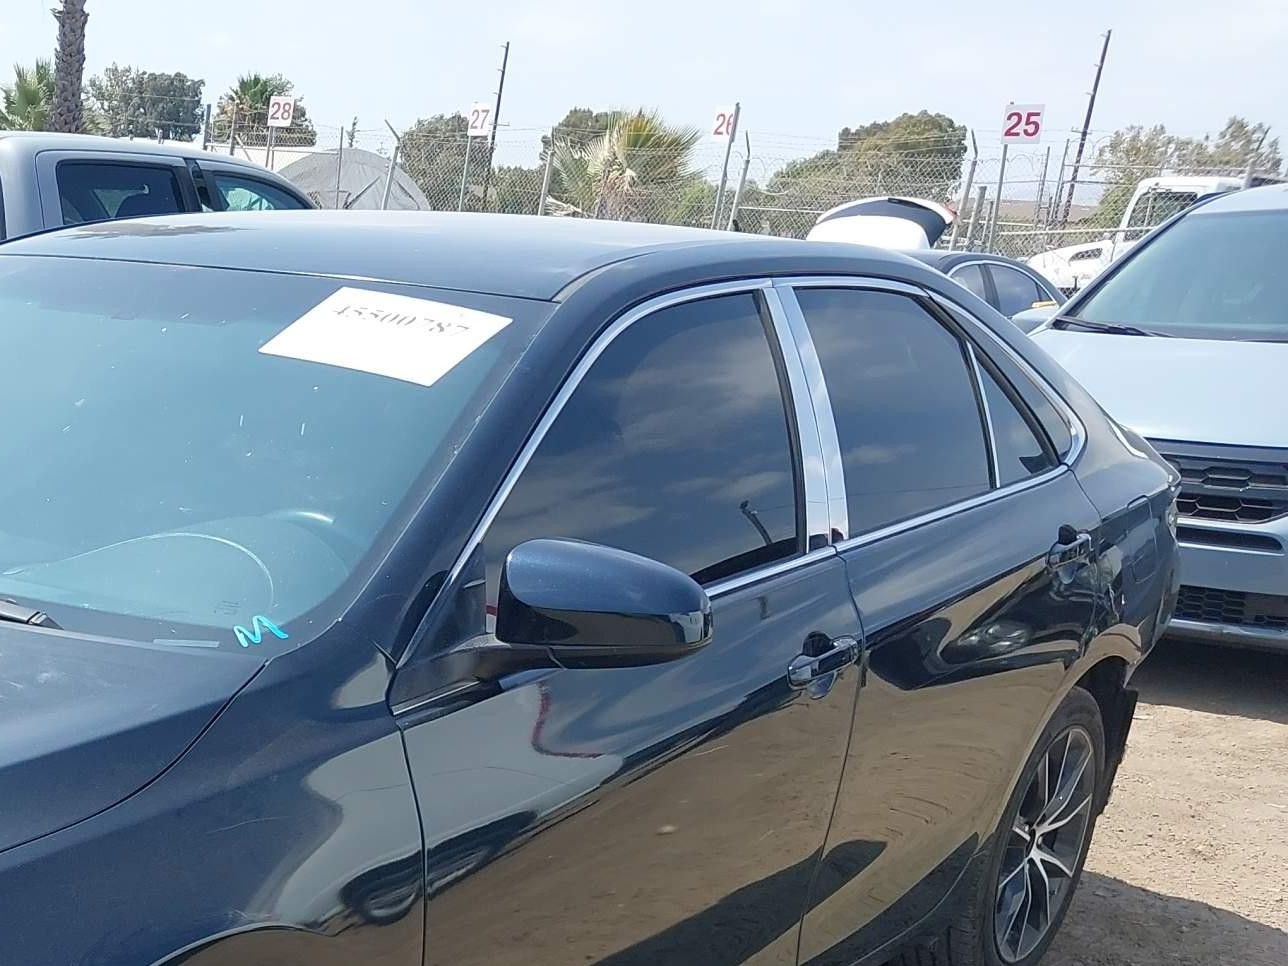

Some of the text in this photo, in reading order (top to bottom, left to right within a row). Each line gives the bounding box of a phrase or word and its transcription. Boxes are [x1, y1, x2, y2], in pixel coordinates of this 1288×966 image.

[270, 101, 292, 120] 28
[470, 109, 490, 130] 27
[1004, 111, 1041, 137] 25
[233, 614, 289, 648] M
